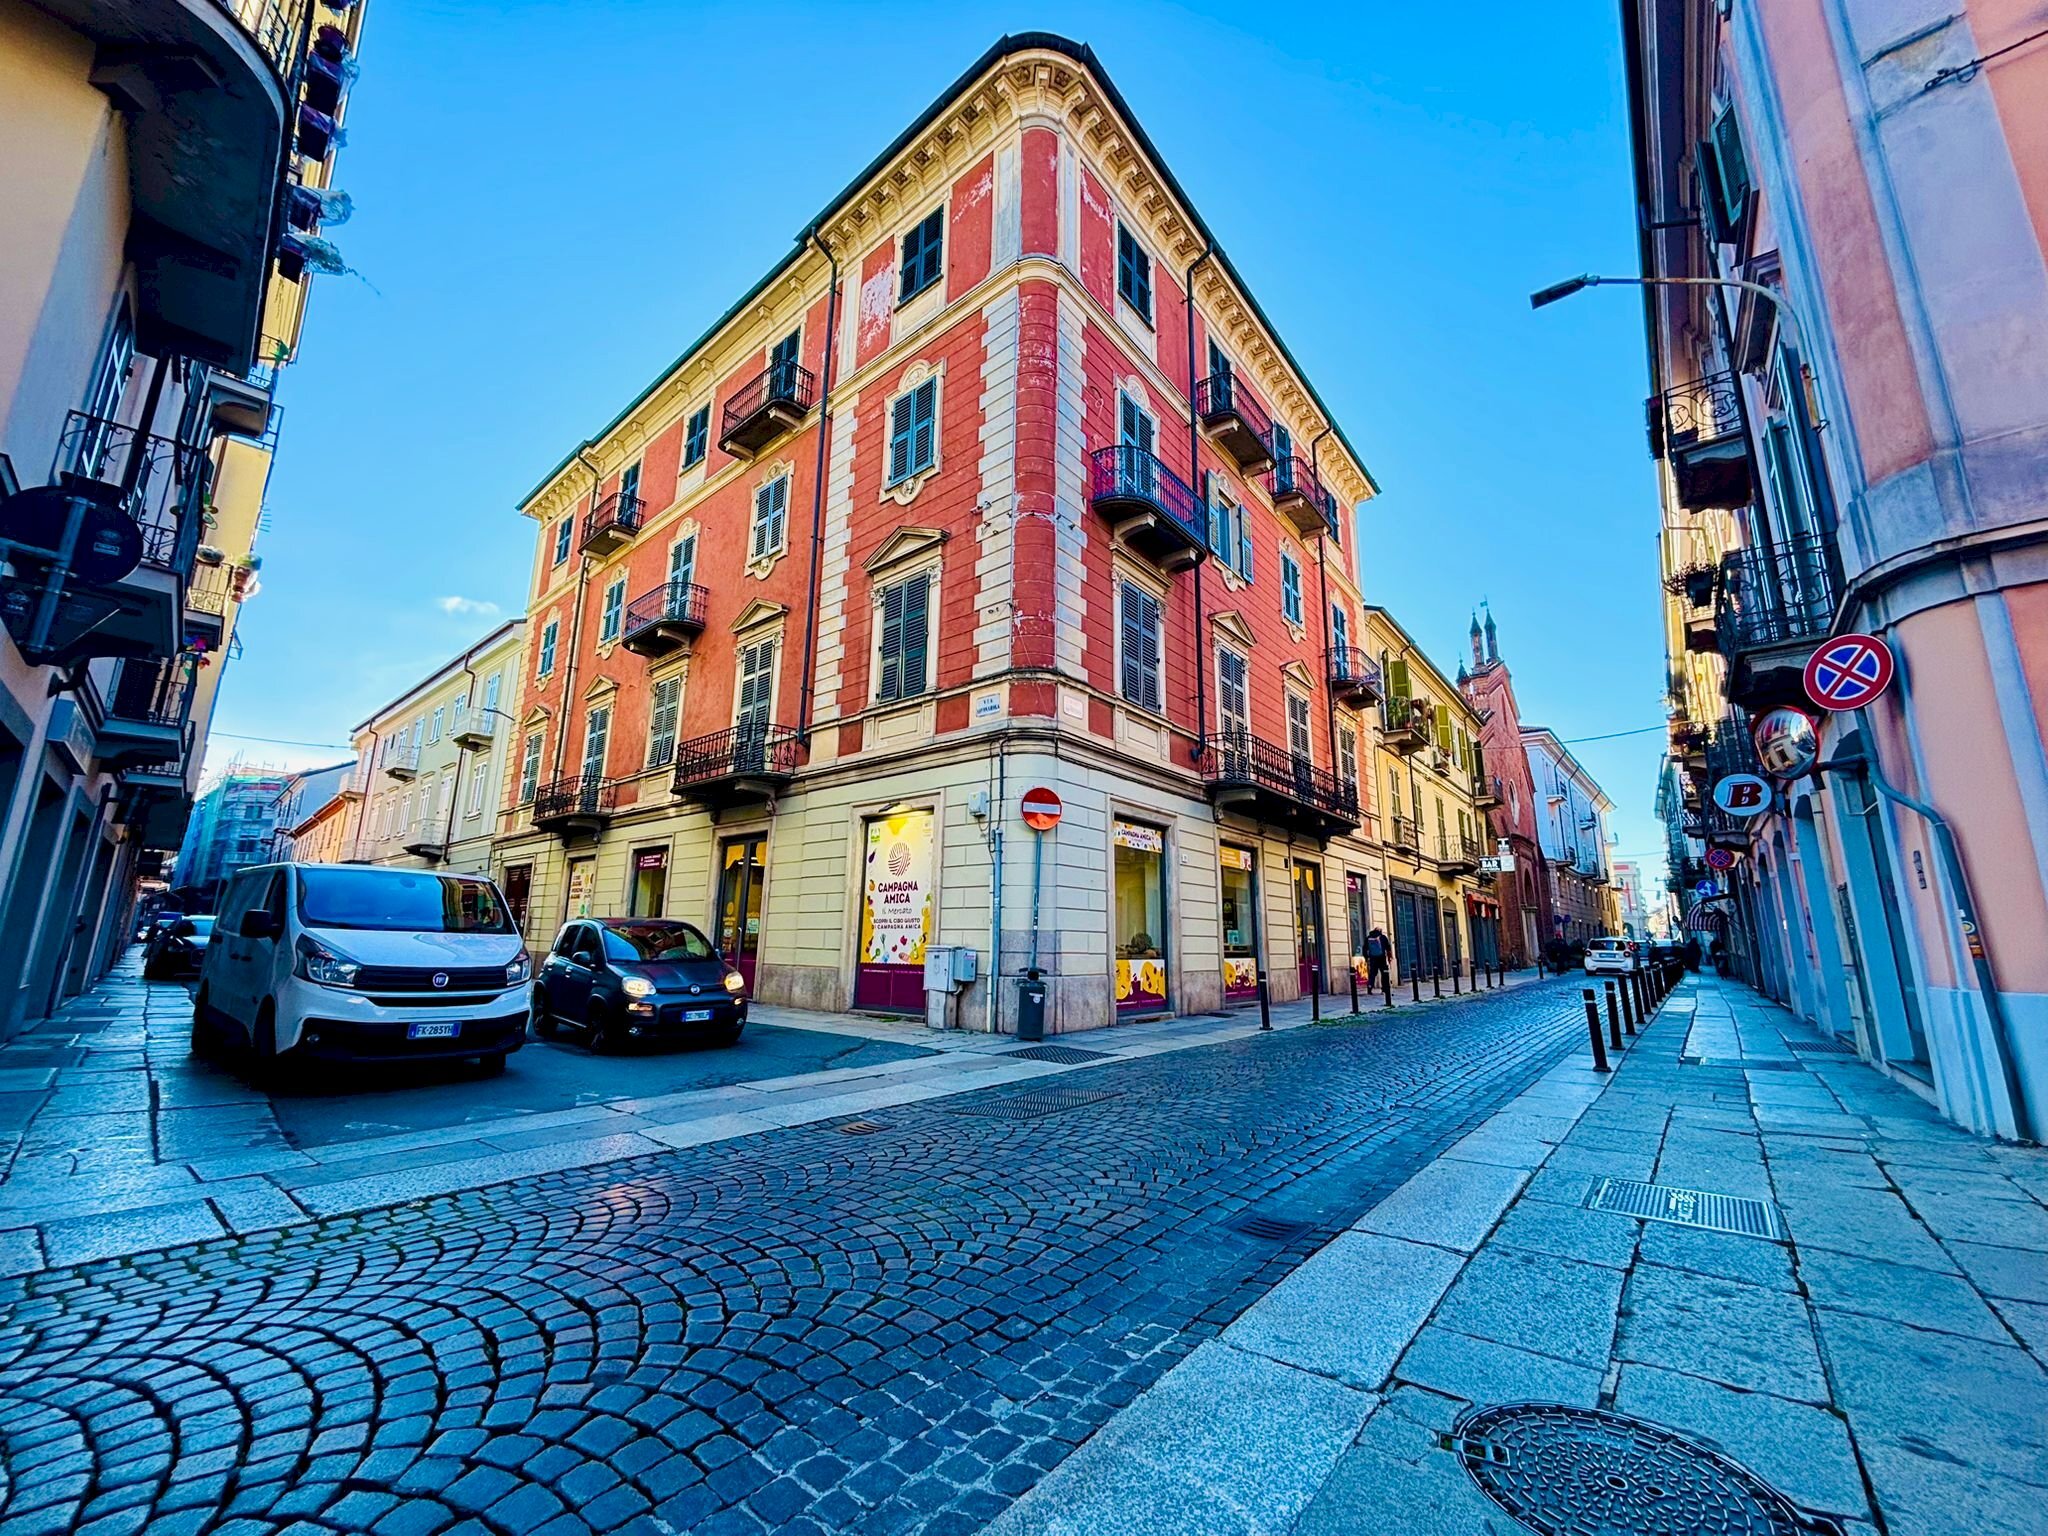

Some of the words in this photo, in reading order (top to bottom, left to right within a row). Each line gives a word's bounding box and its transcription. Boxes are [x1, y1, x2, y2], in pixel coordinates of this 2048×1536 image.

[1724, 781, 1763, 809] B
[878, 881, 918, 893] CAMPAGNA
[884, 893, 910, 904] AMICA
